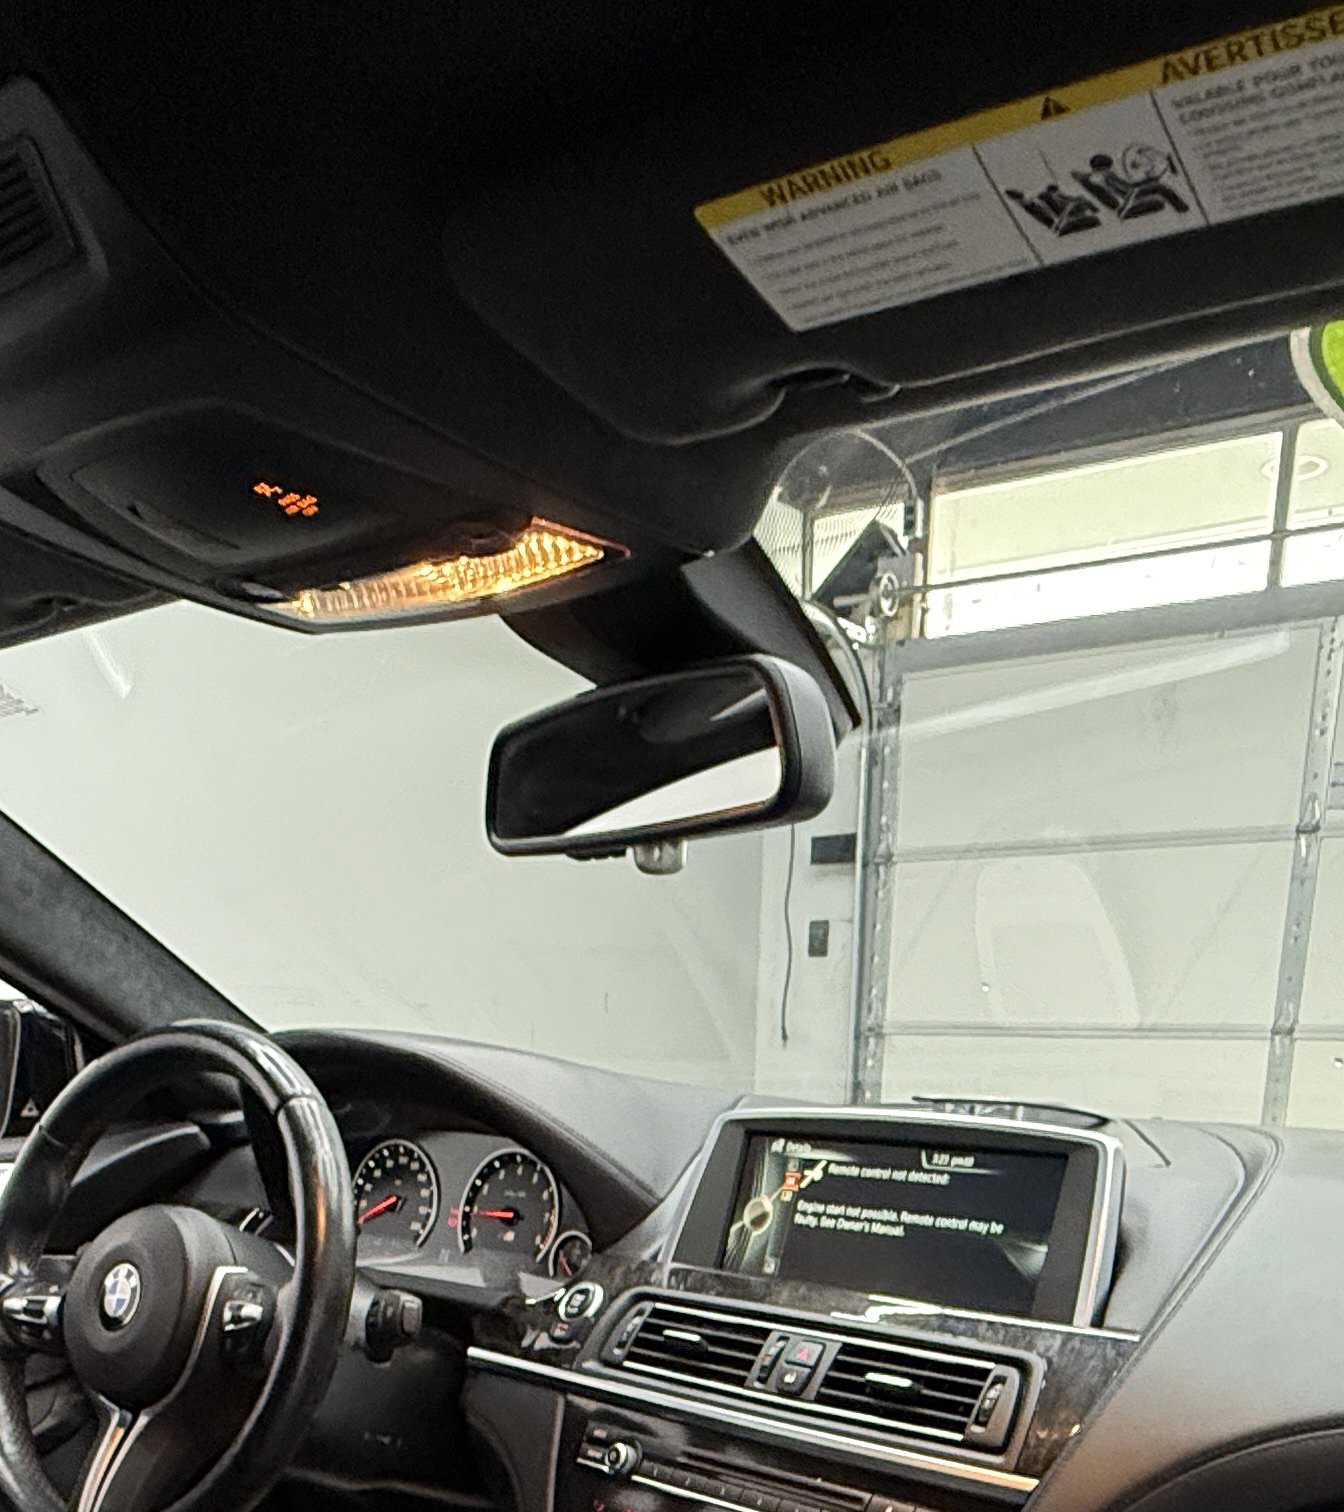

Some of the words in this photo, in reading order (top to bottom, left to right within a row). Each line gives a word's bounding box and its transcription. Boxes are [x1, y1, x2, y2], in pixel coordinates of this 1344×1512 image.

[759, 151, 892, 207] WARNING
[861, 1167, 891, 1180] control
[935, 1216, 968, 1231] control
[969, 1220, 989, 1235] may
[990, 1221, 1004, 1235] be
